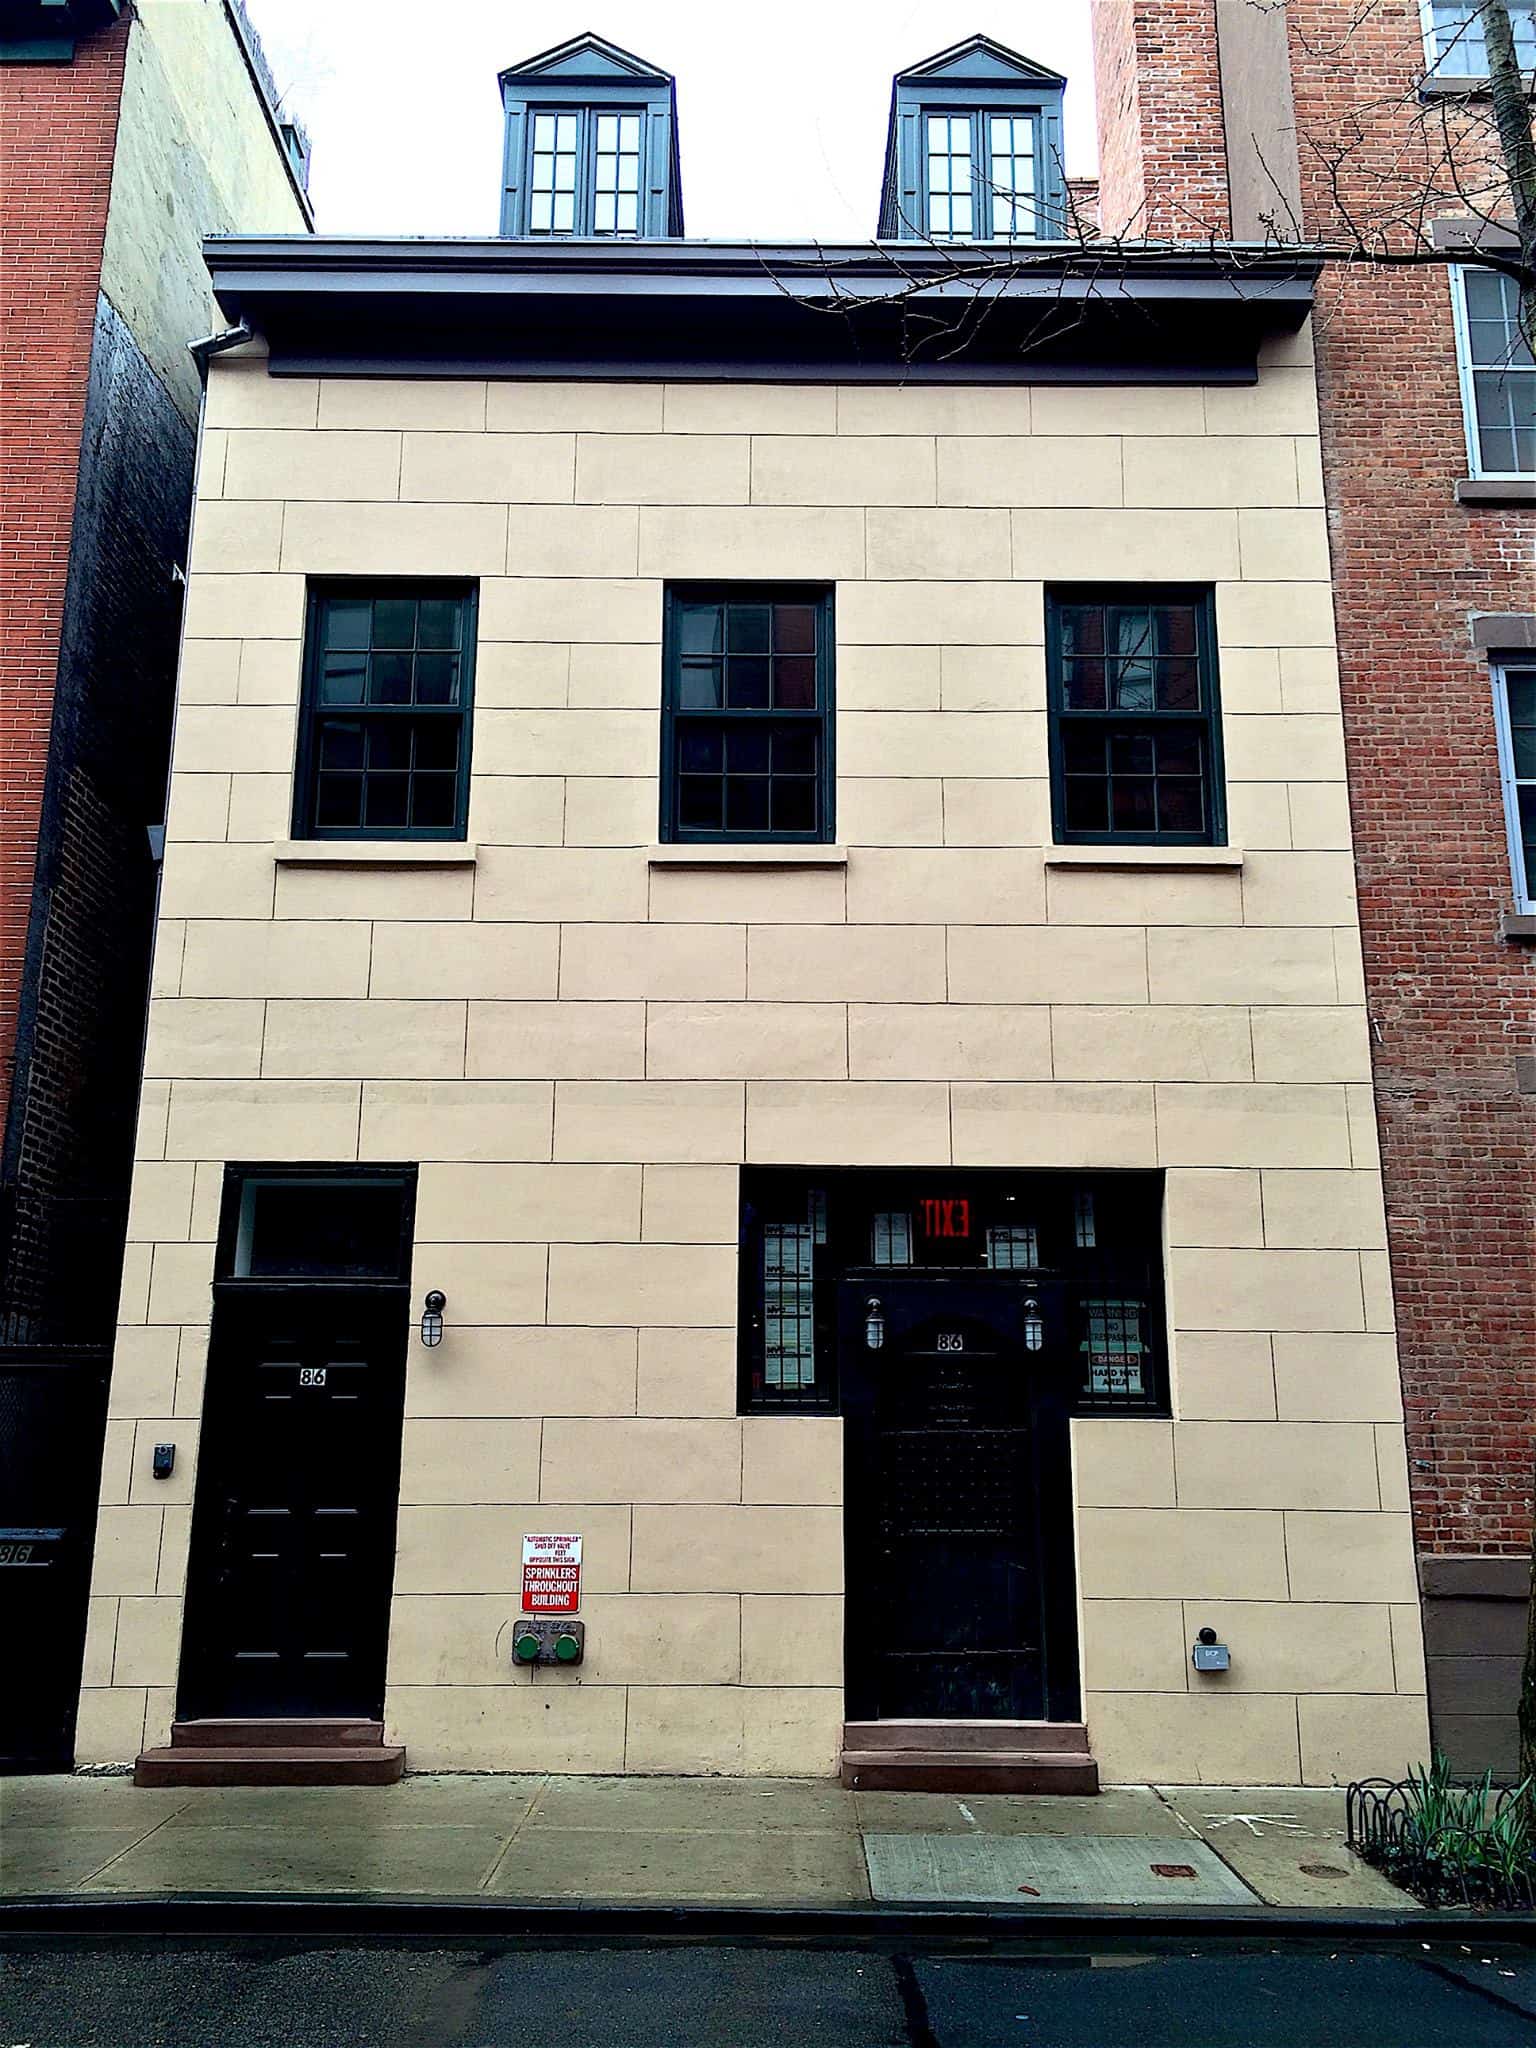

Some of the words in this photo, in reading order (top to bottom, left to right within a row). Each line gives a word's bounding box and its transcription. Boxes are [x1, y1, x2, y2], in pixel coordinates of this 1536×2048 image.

[939, 1334, 962, 1350] 86
[301, 1369, 325, 1385] 86
[0, 1546, 31, 1563] 86
[525, 1567, 577, 1579] SPRINKLERS
[524, 1580, 578, 1592] THROUGHOUT
[532, 1594, 569, 1606] BUILDING
